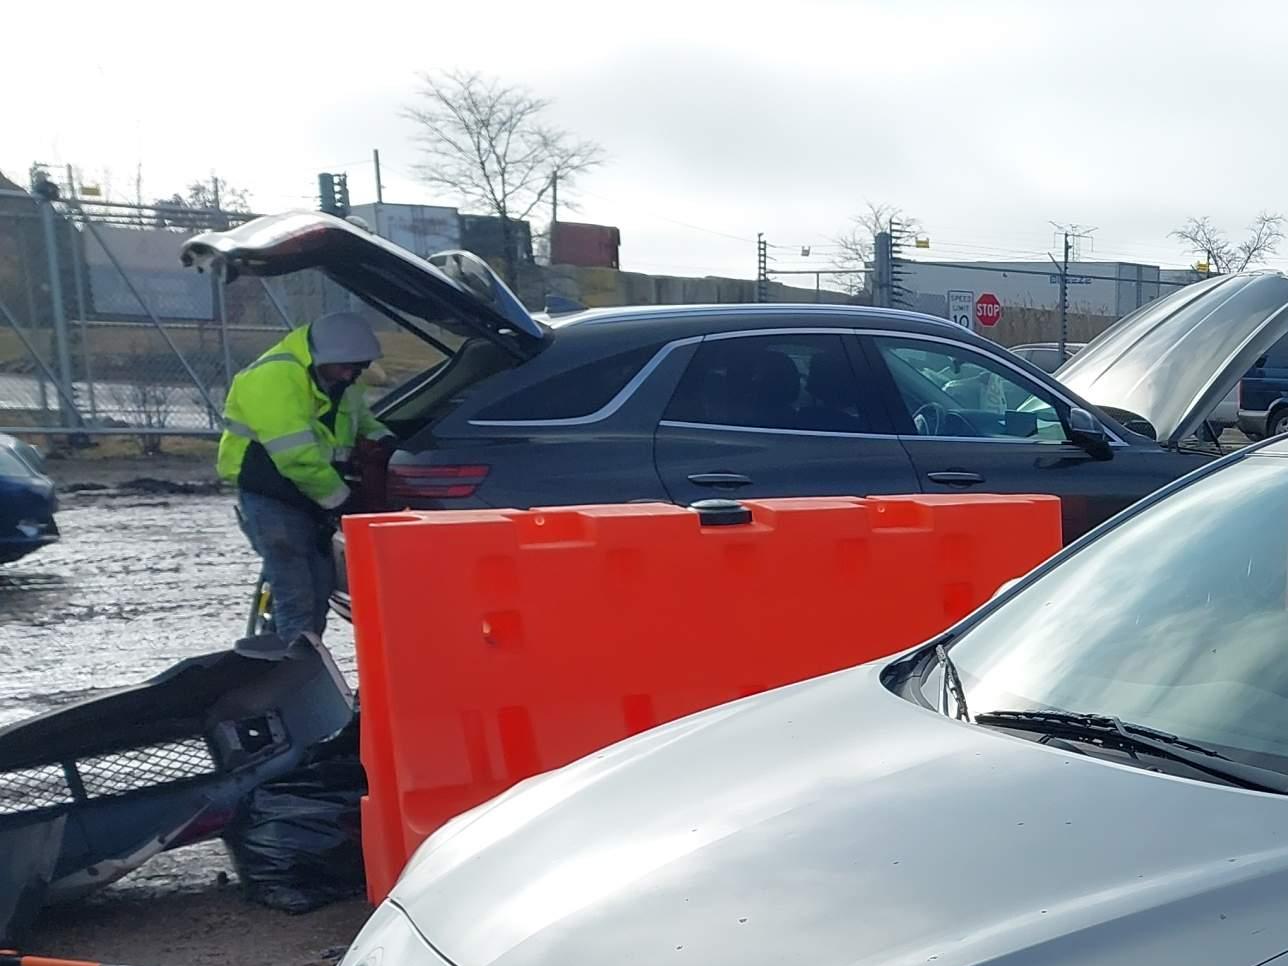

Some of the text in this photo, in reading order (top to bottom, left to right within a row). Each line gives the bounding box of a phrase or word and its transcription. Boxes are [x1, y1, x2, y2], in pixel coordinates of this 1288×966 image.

[951, 295, 971, 303] SPEED
[952, 304, 969, 312] LIMIT
[977, 303, 1000, 317] STOP
